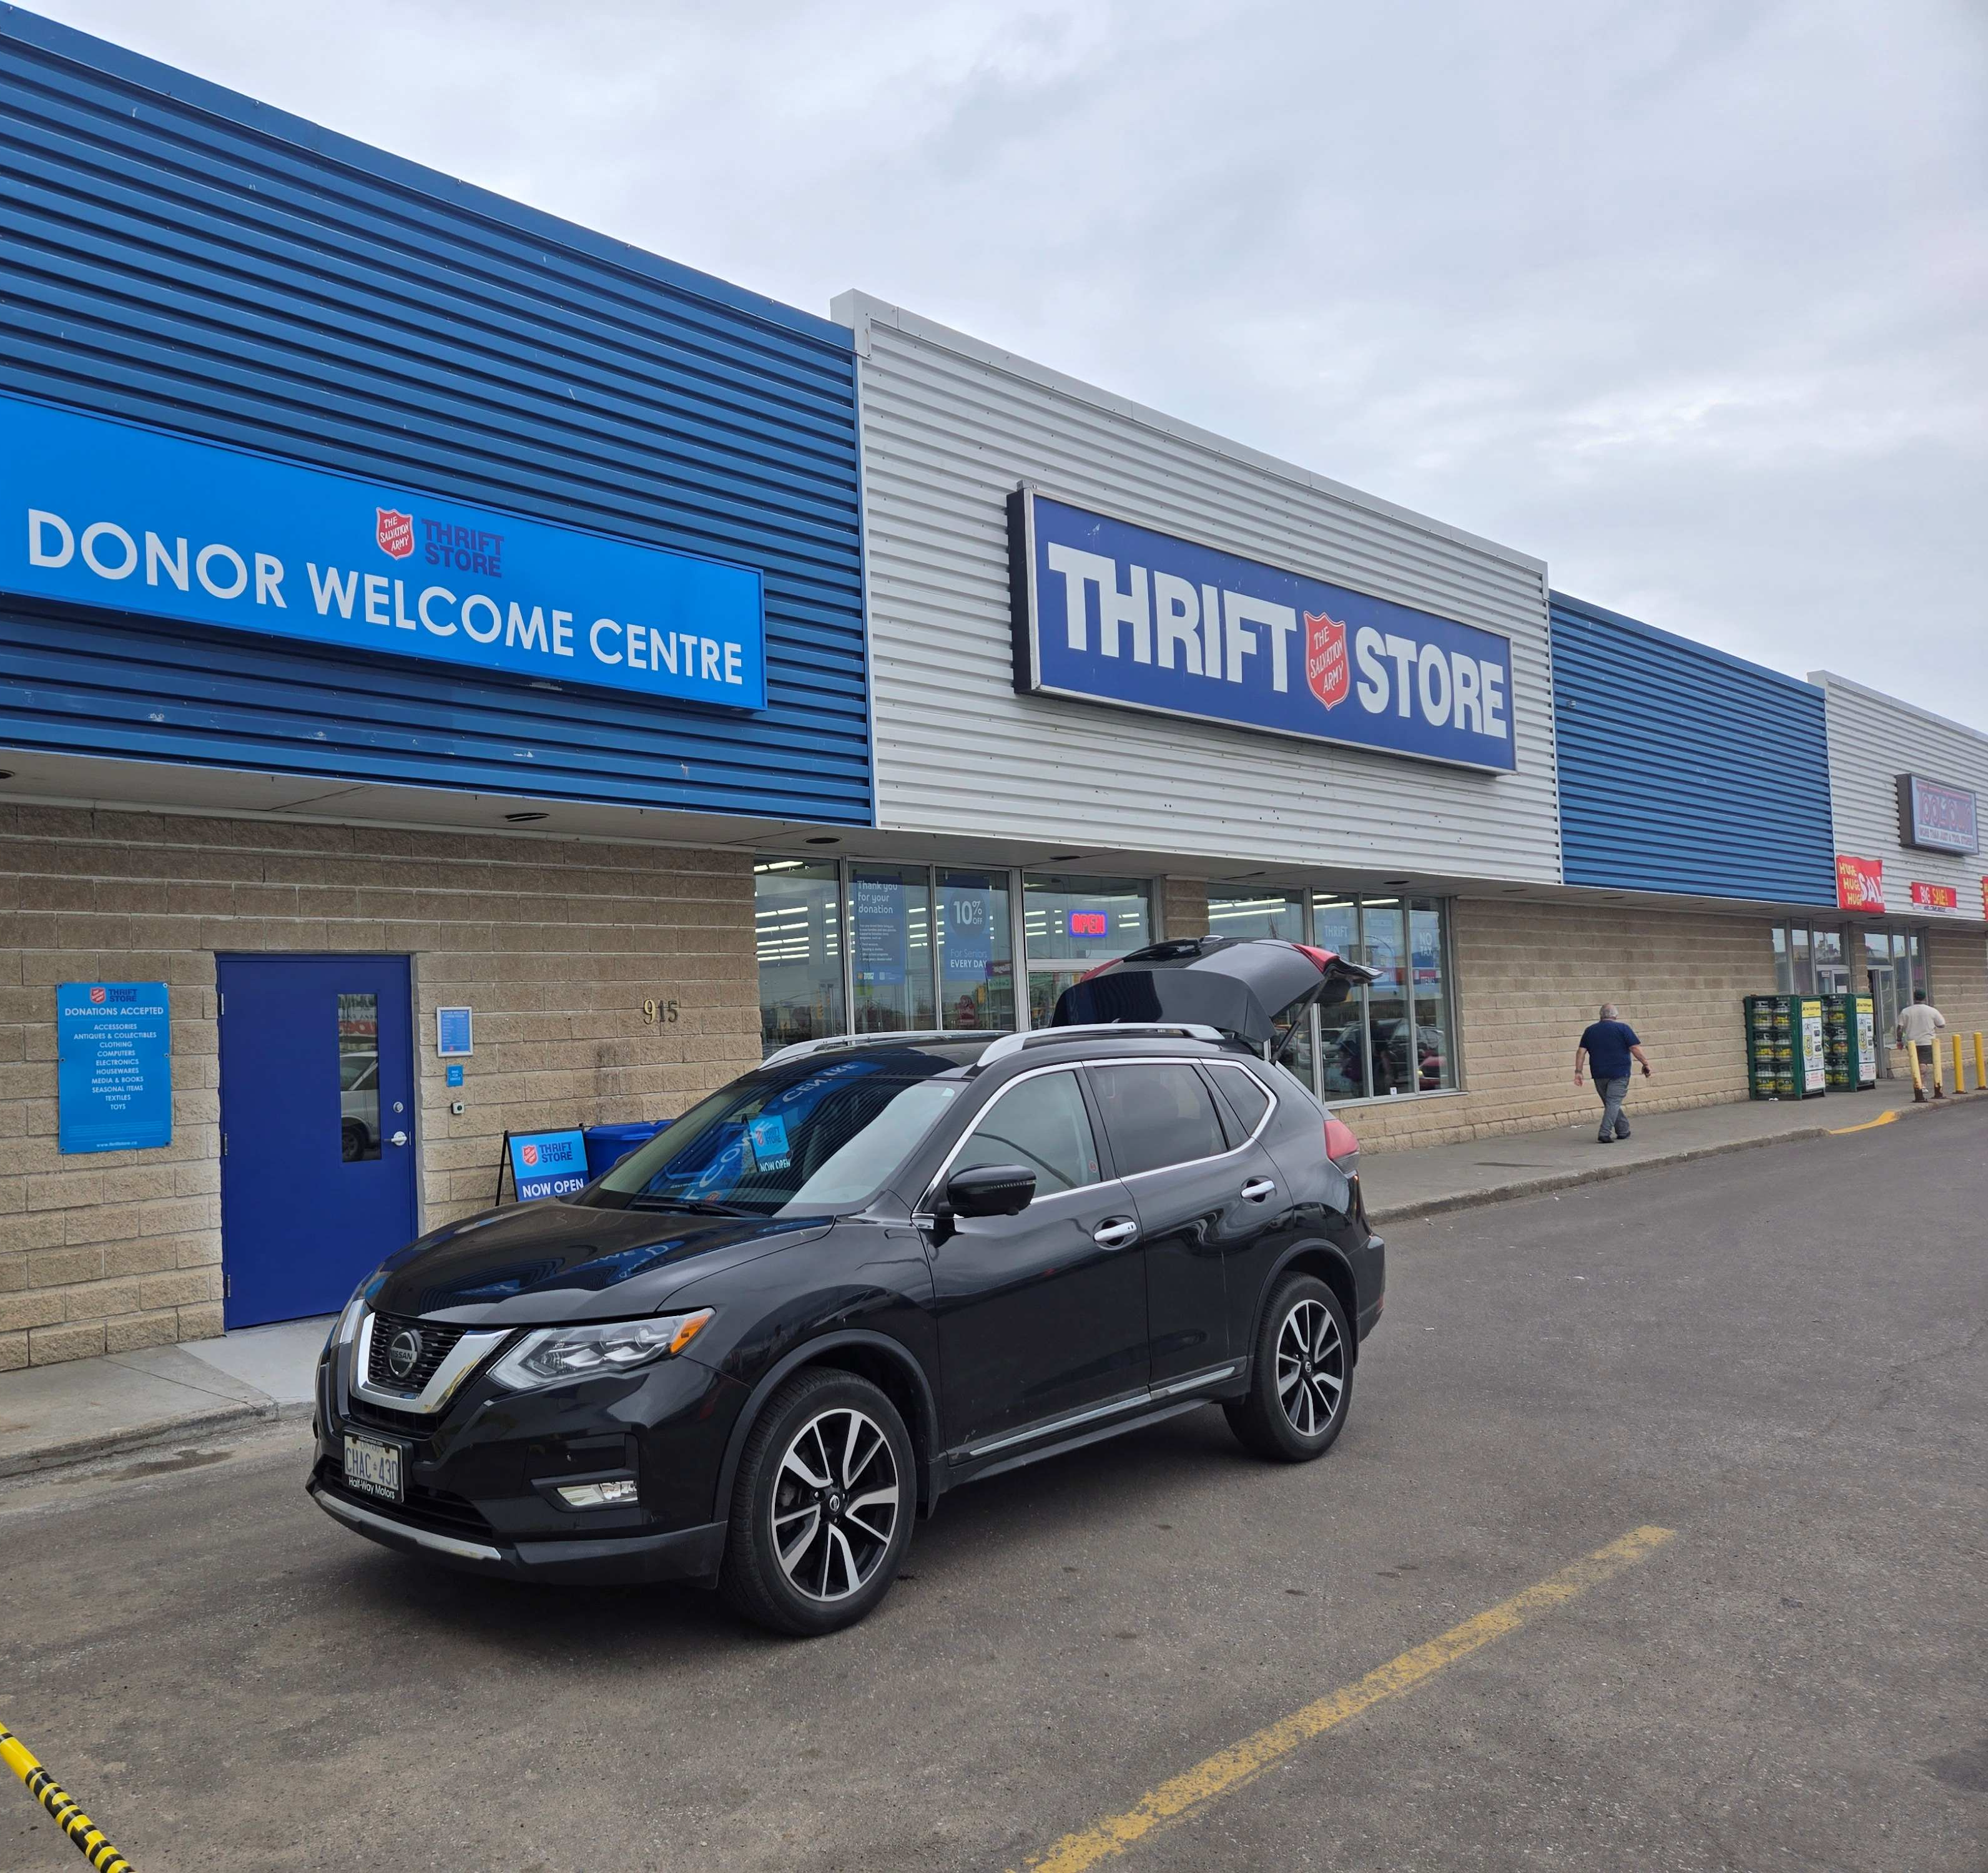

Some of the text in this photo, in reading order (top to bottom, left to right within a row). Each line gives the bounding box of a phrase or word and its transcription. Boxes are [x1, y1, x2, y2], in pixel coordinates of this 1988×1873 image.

[383, 516, 398, 529] THE
[380, 522, 410, 543] SALVATION
[420, 518, 504, 556] THRIFT
[391, 534, 410, 551] ARMY
[425, 542, 502, 578] STORE
[28, 508, 743, 685] DONOR WELCOME CENTRE
[1047, 541, 1507, 739] THRIFT STORE
[1314, 626, 1330, 650] THE
[1310, 634, 1344, 679] SALVATION
[1322, 660, 1344, 694] ARMY
[857, 880, 898, 893] Thank you
[858, 892, 890, 904] for your
[1846, 892, 1863, 906] HUG
[859, 903, 893, 914] donation
[953, 900, 982, 925] 10%
[1071, 913, 1105, 934] OPEN
[1419, 932, 1433, 945] NO
[1419, 945, 1434, 957] TAX
[950, 959, 987, 968] EVERY DAY
[64, 1006, 164, 1016] DONATIONS ACCEPTED
[643, 999, 679, 1025] 915
[96, 1058, 139, 1066] ELECTRONICS
[539, 1141, 573, 1154] THRIFT
[541, 1151, 573, 1163] STORE
[760, 1159, 791, 1172] NOW OPEN
[522, 1178, 584, 1198] NOW OPEN
[346, 1447, 372, 1479] CHAC
[348, 1476, 395, 1499] Half-Way Motors
